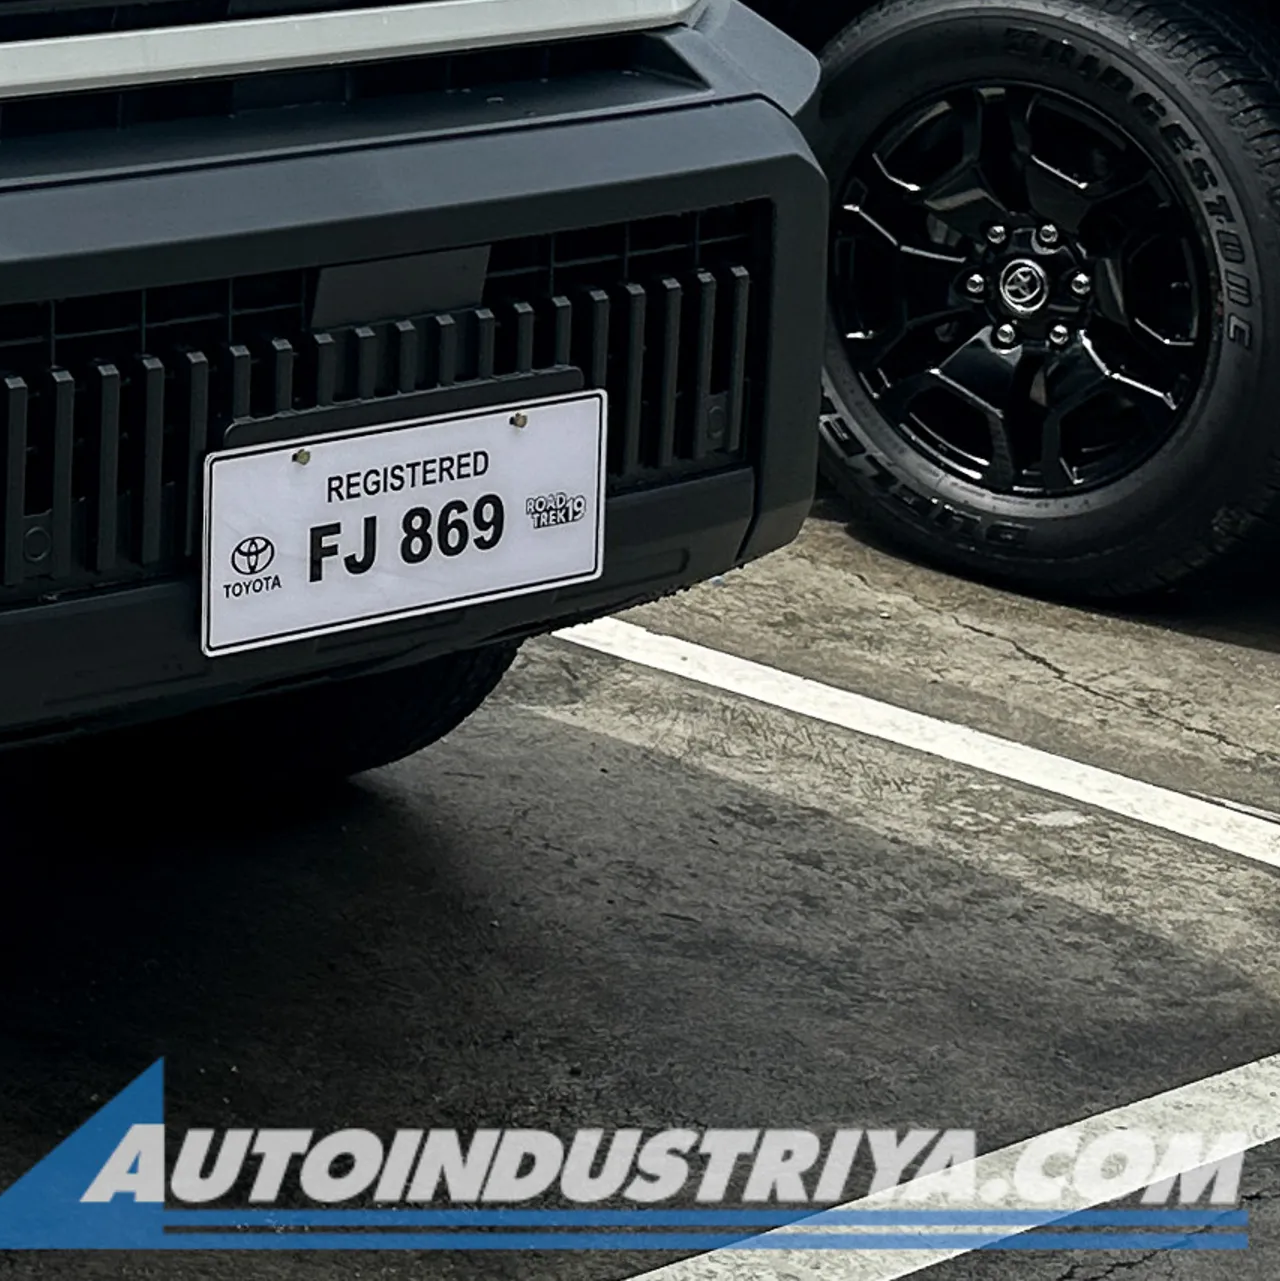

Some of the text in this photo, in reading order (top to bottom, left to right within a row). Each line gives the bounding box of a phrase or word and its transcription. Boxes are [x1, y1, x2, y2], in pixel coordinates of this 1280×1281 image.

[327, 449, 490, 503] REGISTERED
[526, 492, 567, 515] ROAD
[309, 493, 505, 583] FJ 869
[223, 576, 282, 598] TOYOTA
